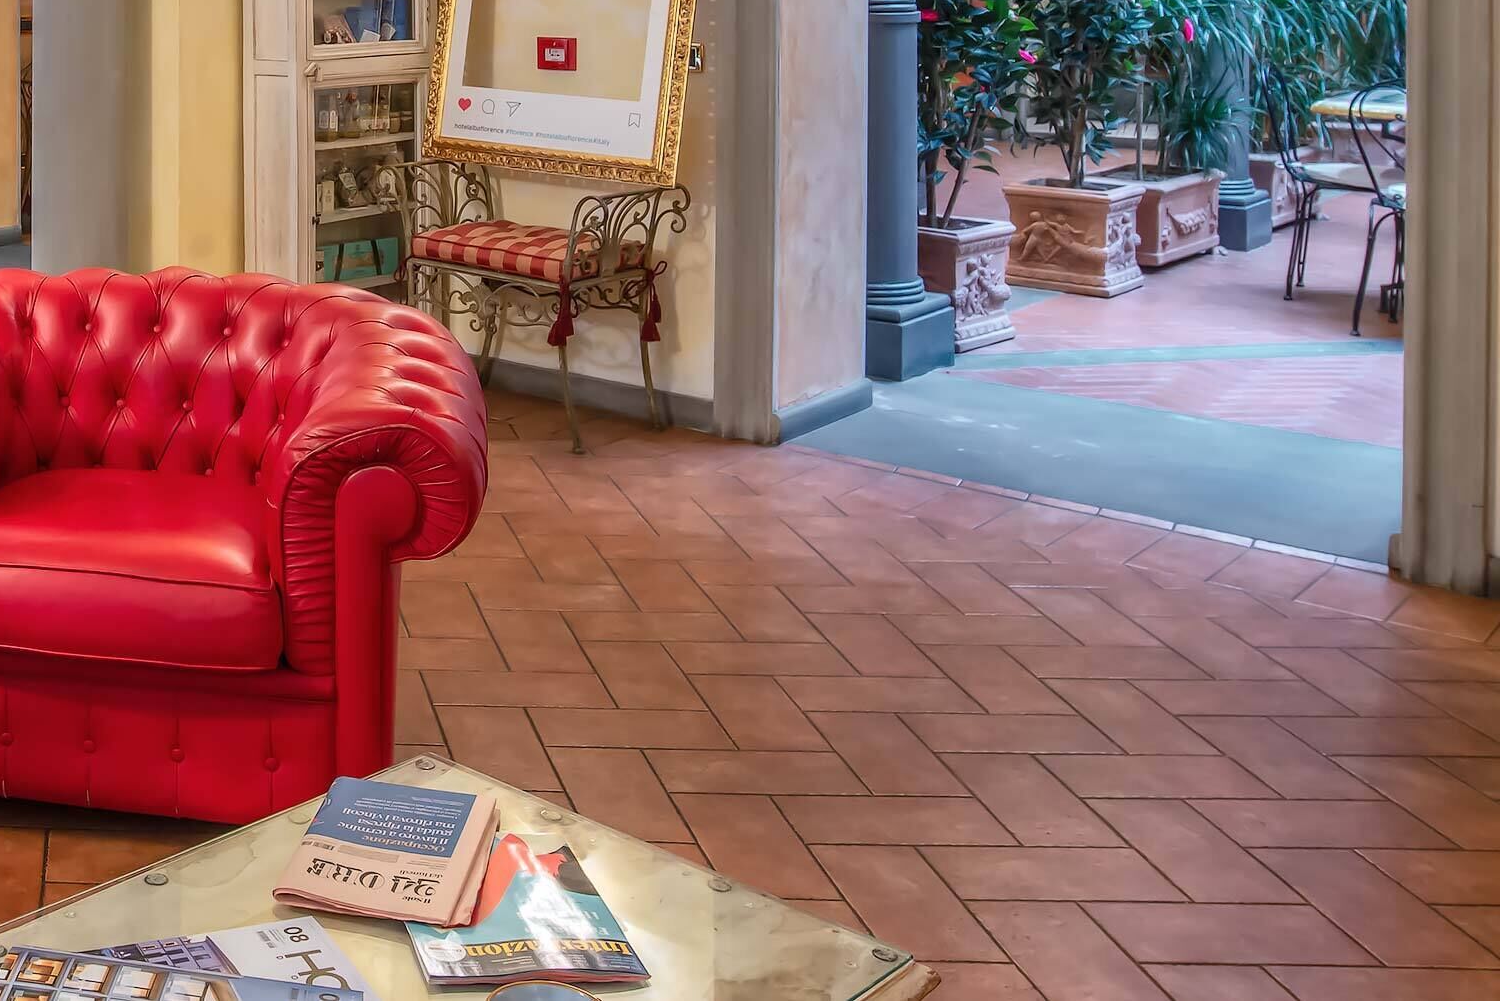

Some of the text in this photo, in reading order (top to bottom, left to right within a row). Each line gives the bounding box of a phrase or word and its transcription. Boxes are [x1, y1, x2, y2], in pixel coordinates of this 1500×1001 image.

[357, 818, 454, 837] guida la ripresa
[392, 815, 431, 827] ritrova
[435, 821, 456, 829] ma
[337, 821, 387, 835] termine
[363, 835, 445, 854] Occupazione
[399, 833, 437, 844] lavoro
[439, 837, 449, 845] Il
[306, 857, 441, 897] 24 ORE
